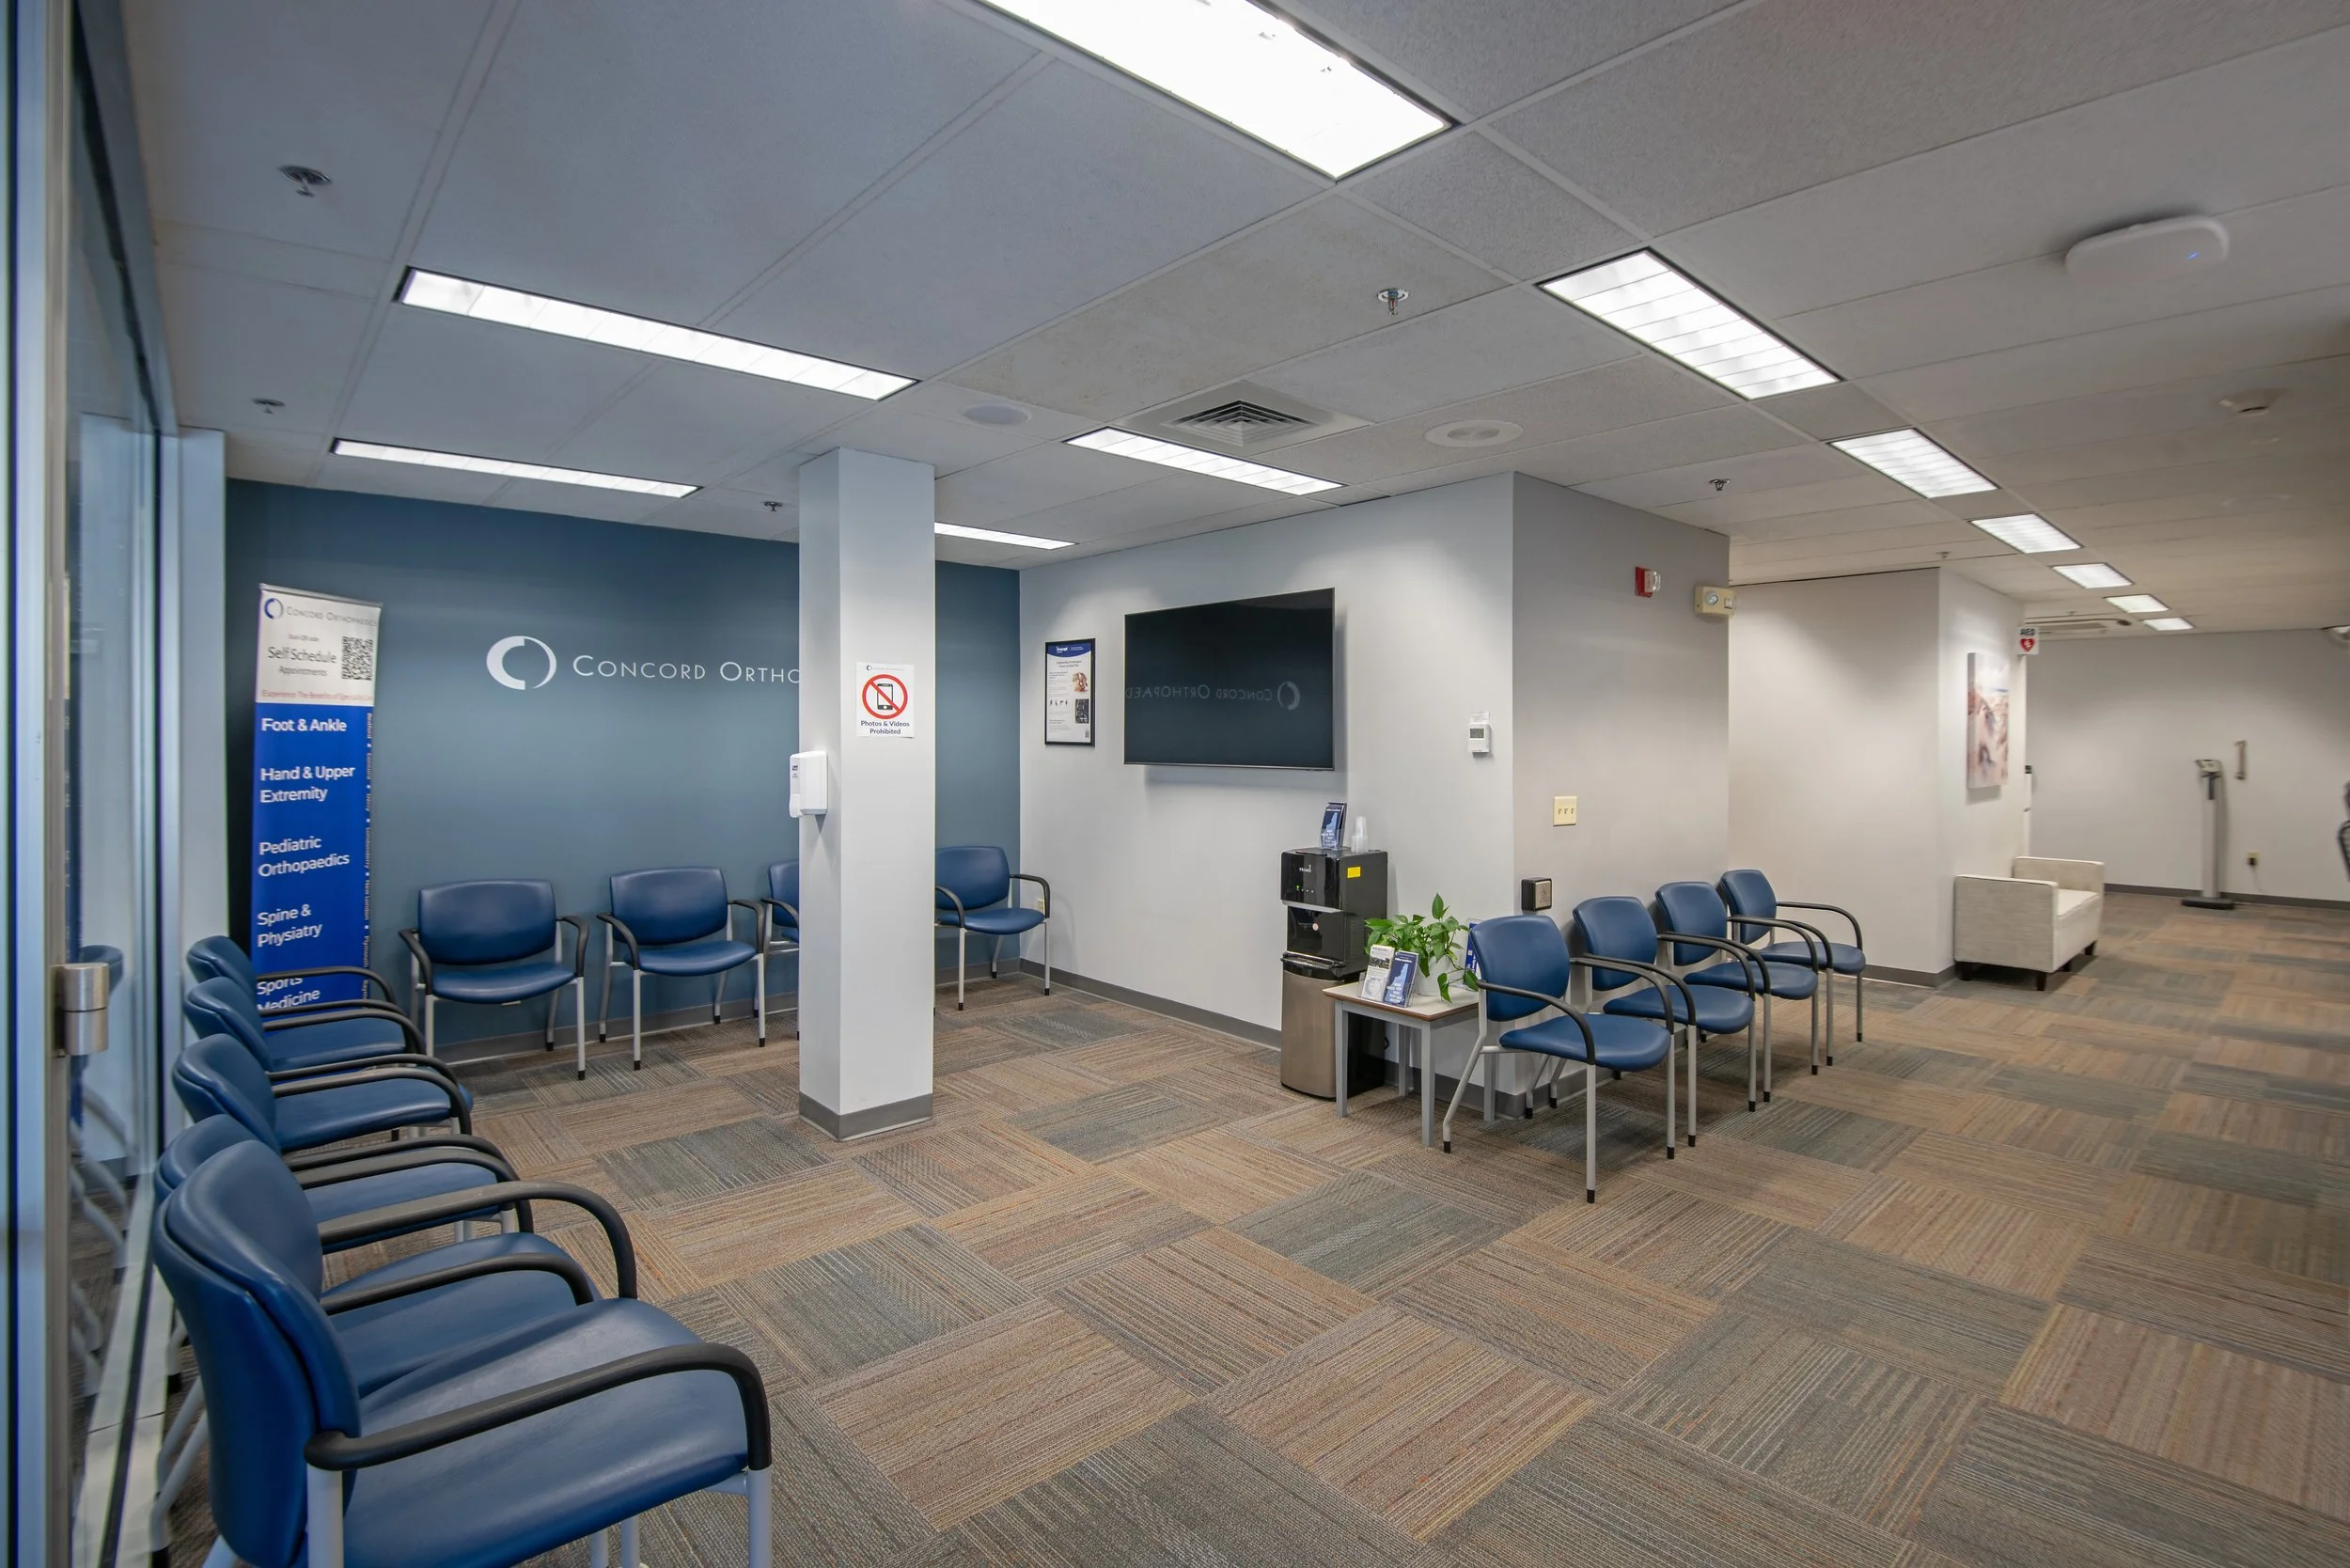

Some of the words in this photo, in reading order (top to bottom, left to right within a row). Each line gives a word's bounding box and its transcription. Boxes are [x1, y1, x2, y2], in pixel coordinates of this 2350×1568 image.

[267, 646, 290, 659] Self
[290, 647, 337, 664] Schedule
[279, 666, 328, 676] Appointments
[572, 654, 706, 680] CONCORD
[260, 717, 295, 732] Foot
[297, 718, 308, 731] &
[309, 718, 347, 732] Ankle
[259, 766, 300, 781] Hand
[302, 766, 313, 779] &
[315, 765, 355, 781] Upper
[259, 786, 328, 803] Extremity
[258, 836, 322, 855] Pediatric
[258, 854, 351, 877] Orthopaedics
[257, 908, 299, 926] Spine
[300, 903, 311, 917] &
[257, 923, 323, 948] Physiatry
[257, 978, 304, 996] Sports
